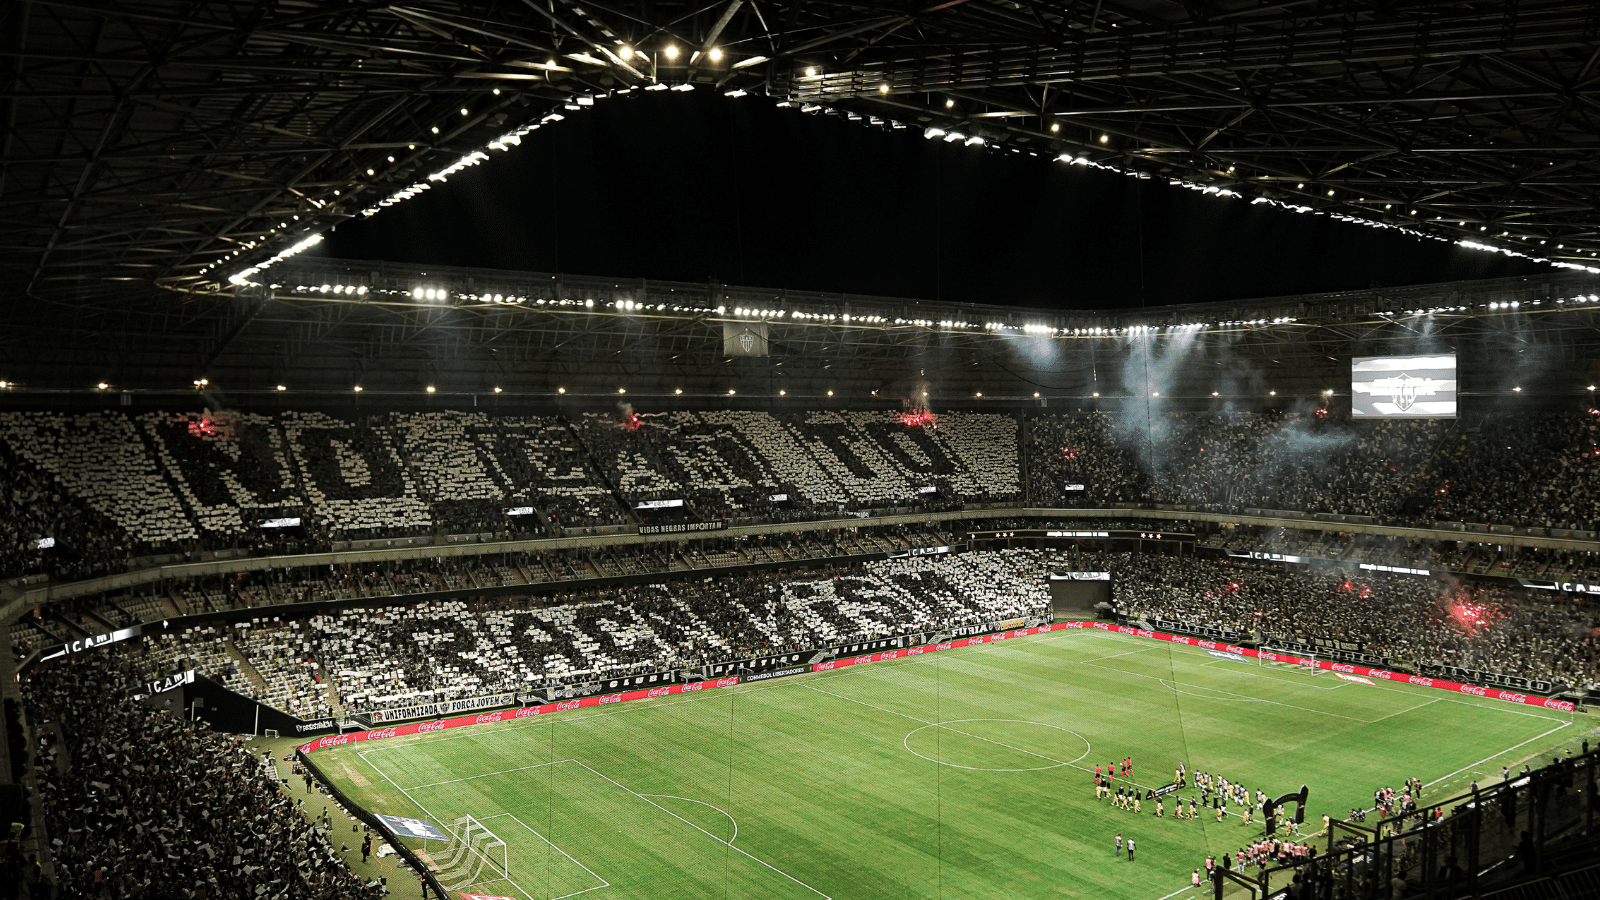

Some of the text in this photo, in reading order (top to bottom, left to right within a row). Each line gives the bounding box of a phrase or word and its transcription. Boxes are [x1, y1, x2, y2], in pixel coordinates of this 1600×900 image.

[639, 526, 659, 534] VIDAS
[661, 524, 685, 533] NEGRAS
[72, 634, 107, 652] CAM
[154, 673, 183, 693] CAM
[747, 667, 804, 681] CONMEBOL LIBERTADORES
[384, 704, 438, 720] UNIFORMIZADA
[476, 696, 500, 708] JOVEM
